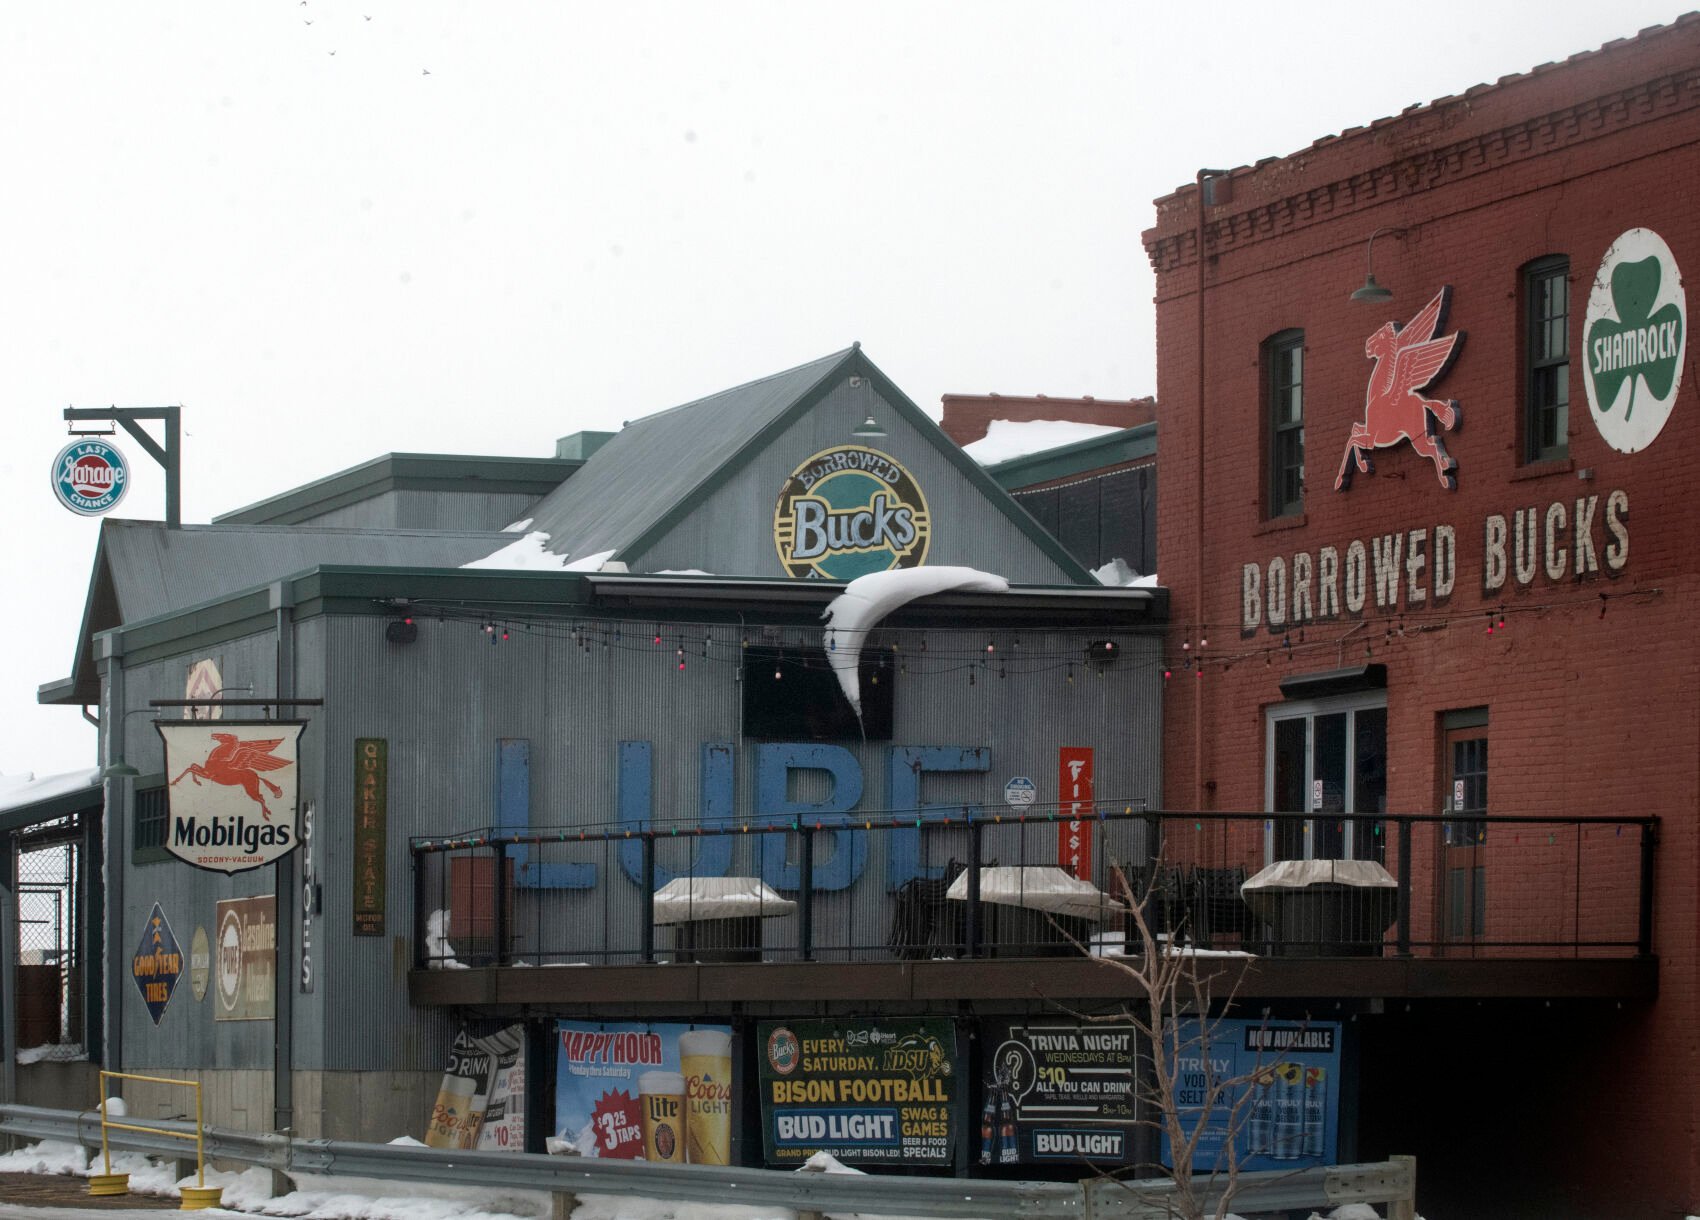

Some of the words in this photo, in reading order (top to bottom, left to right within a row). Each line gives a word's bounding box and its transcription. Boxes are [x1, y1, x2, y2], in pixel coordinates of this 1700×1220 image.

[1594, 320, 1677, 375] SHAMROCK
[77, 446, 108, 456] LAST
[59, 456, 124, 484] Garage
[797, 451, 900, 490] BORROWED
[70, 493, 113, 507] CHANCE
[793, 495, 915, 559] Bucks
[1242, 525, 1456, 632] BORROWED
[1484, 490, 1629, 592] BUCKS
[363, 743, 378, 829] QUAKER
[497, 739, 991, 891] LUBE
[1068, 760, 1086, 880] Firest
[175, 816, 290, 854] Mobilgas
[303, 810, 312, 984] SHOES
[134, 953, 179, 977] GOODYEAR
[145, 982, 168, 1003] TIRES
[613, 1033, 662, 1064] HOUR
[1029, 1036, 1079, 1051] TRIVIA
[1083, 1035, 1130, 1050] NIGHT
[1249, 1030, 1272, 1047] NOW
[1274, 1031, 1331, 1048] AVAILABLE
[773, 1043, 794, 1060] Bucks
[883, 1050, 928, 1071] NDSU
[1045, 1053, 1104, 1063] WEDNESDAYS
[1106, 1053, 1115, 1062] AT
[603, 1066, 631, 1078] Saturday
[1038, 1067, 1066, 1084] $10
[686, 1076, 731, 1099] Coors
[773, 1080, 835, 1103] BISON
[839, 1079, 948, 1102] FOOTBALL
[1036, 1082, 1055, 1092] ALL
[1059, 1082, 1078, 1092] YOU
[1081, 1082, 1100, 1092] CAN
[1103, 1082, 1131, 1093] DRINK
[1179, 1090, 1225, 1105] SELTR
[649, 1098, 678, 1122] Lite
[692, 1102, 729, 1114] LIGHT
[902, 1107, 937, 1121] SWAG
[940, 1107, 948, 1120] &
[617, 1125, 641, 1144] TAPS
[778, 1115, 826, 1139] BUD
[829, 1115, 894, 1138] LIGHT
[902, 1122, 948, 1137] GAMES
[777, 1149, 801, 1157] GRAND
[840, 1149, 861, 1157] LIGHT
[862, 1149, 885, 1157] BISON
[904, 1147, 946, 1158] SPECIALS
[1001, 1148, 1017, 1156] BUD
[1037, 1135, 1075, 1153] BUD
[1077, 1136, 1122, 1154] LIGHT
